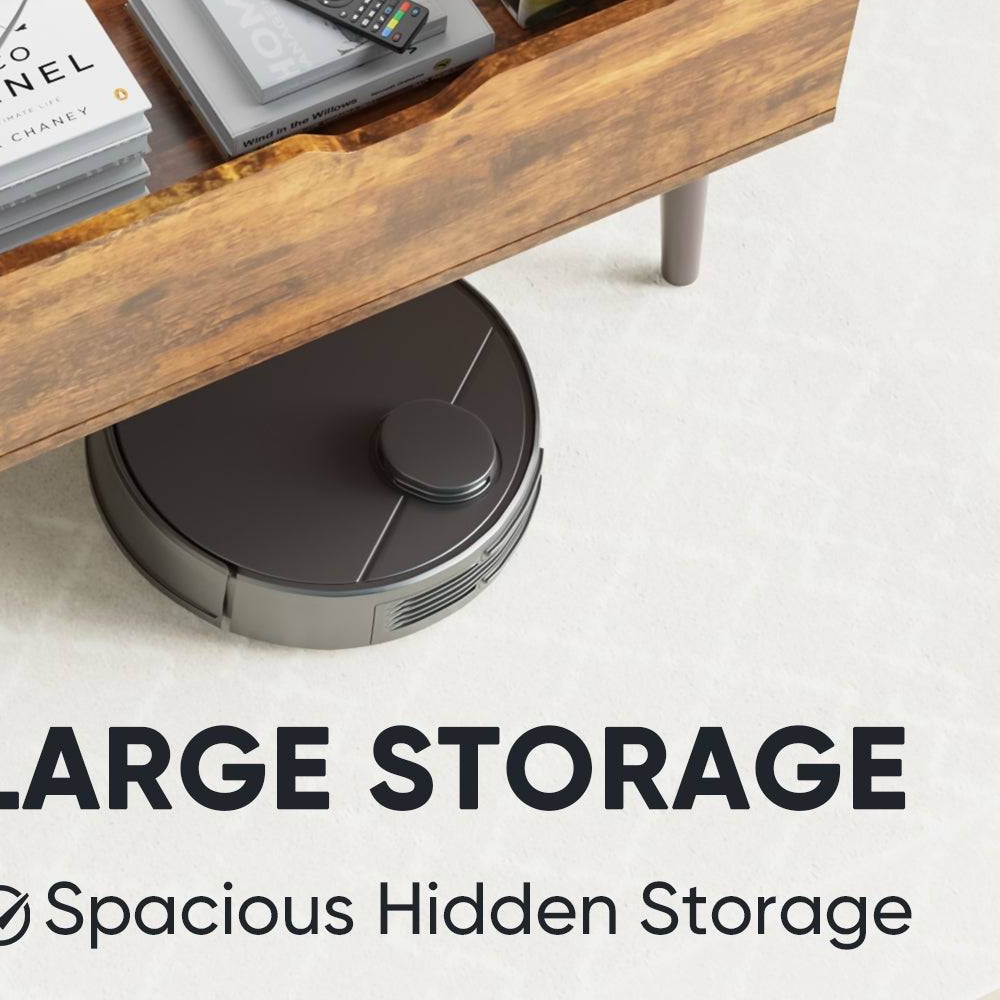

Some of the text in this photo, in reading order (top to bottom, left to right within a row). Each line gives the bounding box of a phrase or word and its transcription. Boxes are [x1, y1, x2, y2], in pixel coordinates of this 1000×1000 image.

[11, 106, 88, 142] CHANEY
[243, 98, 358, 148] Wind in the Willows
